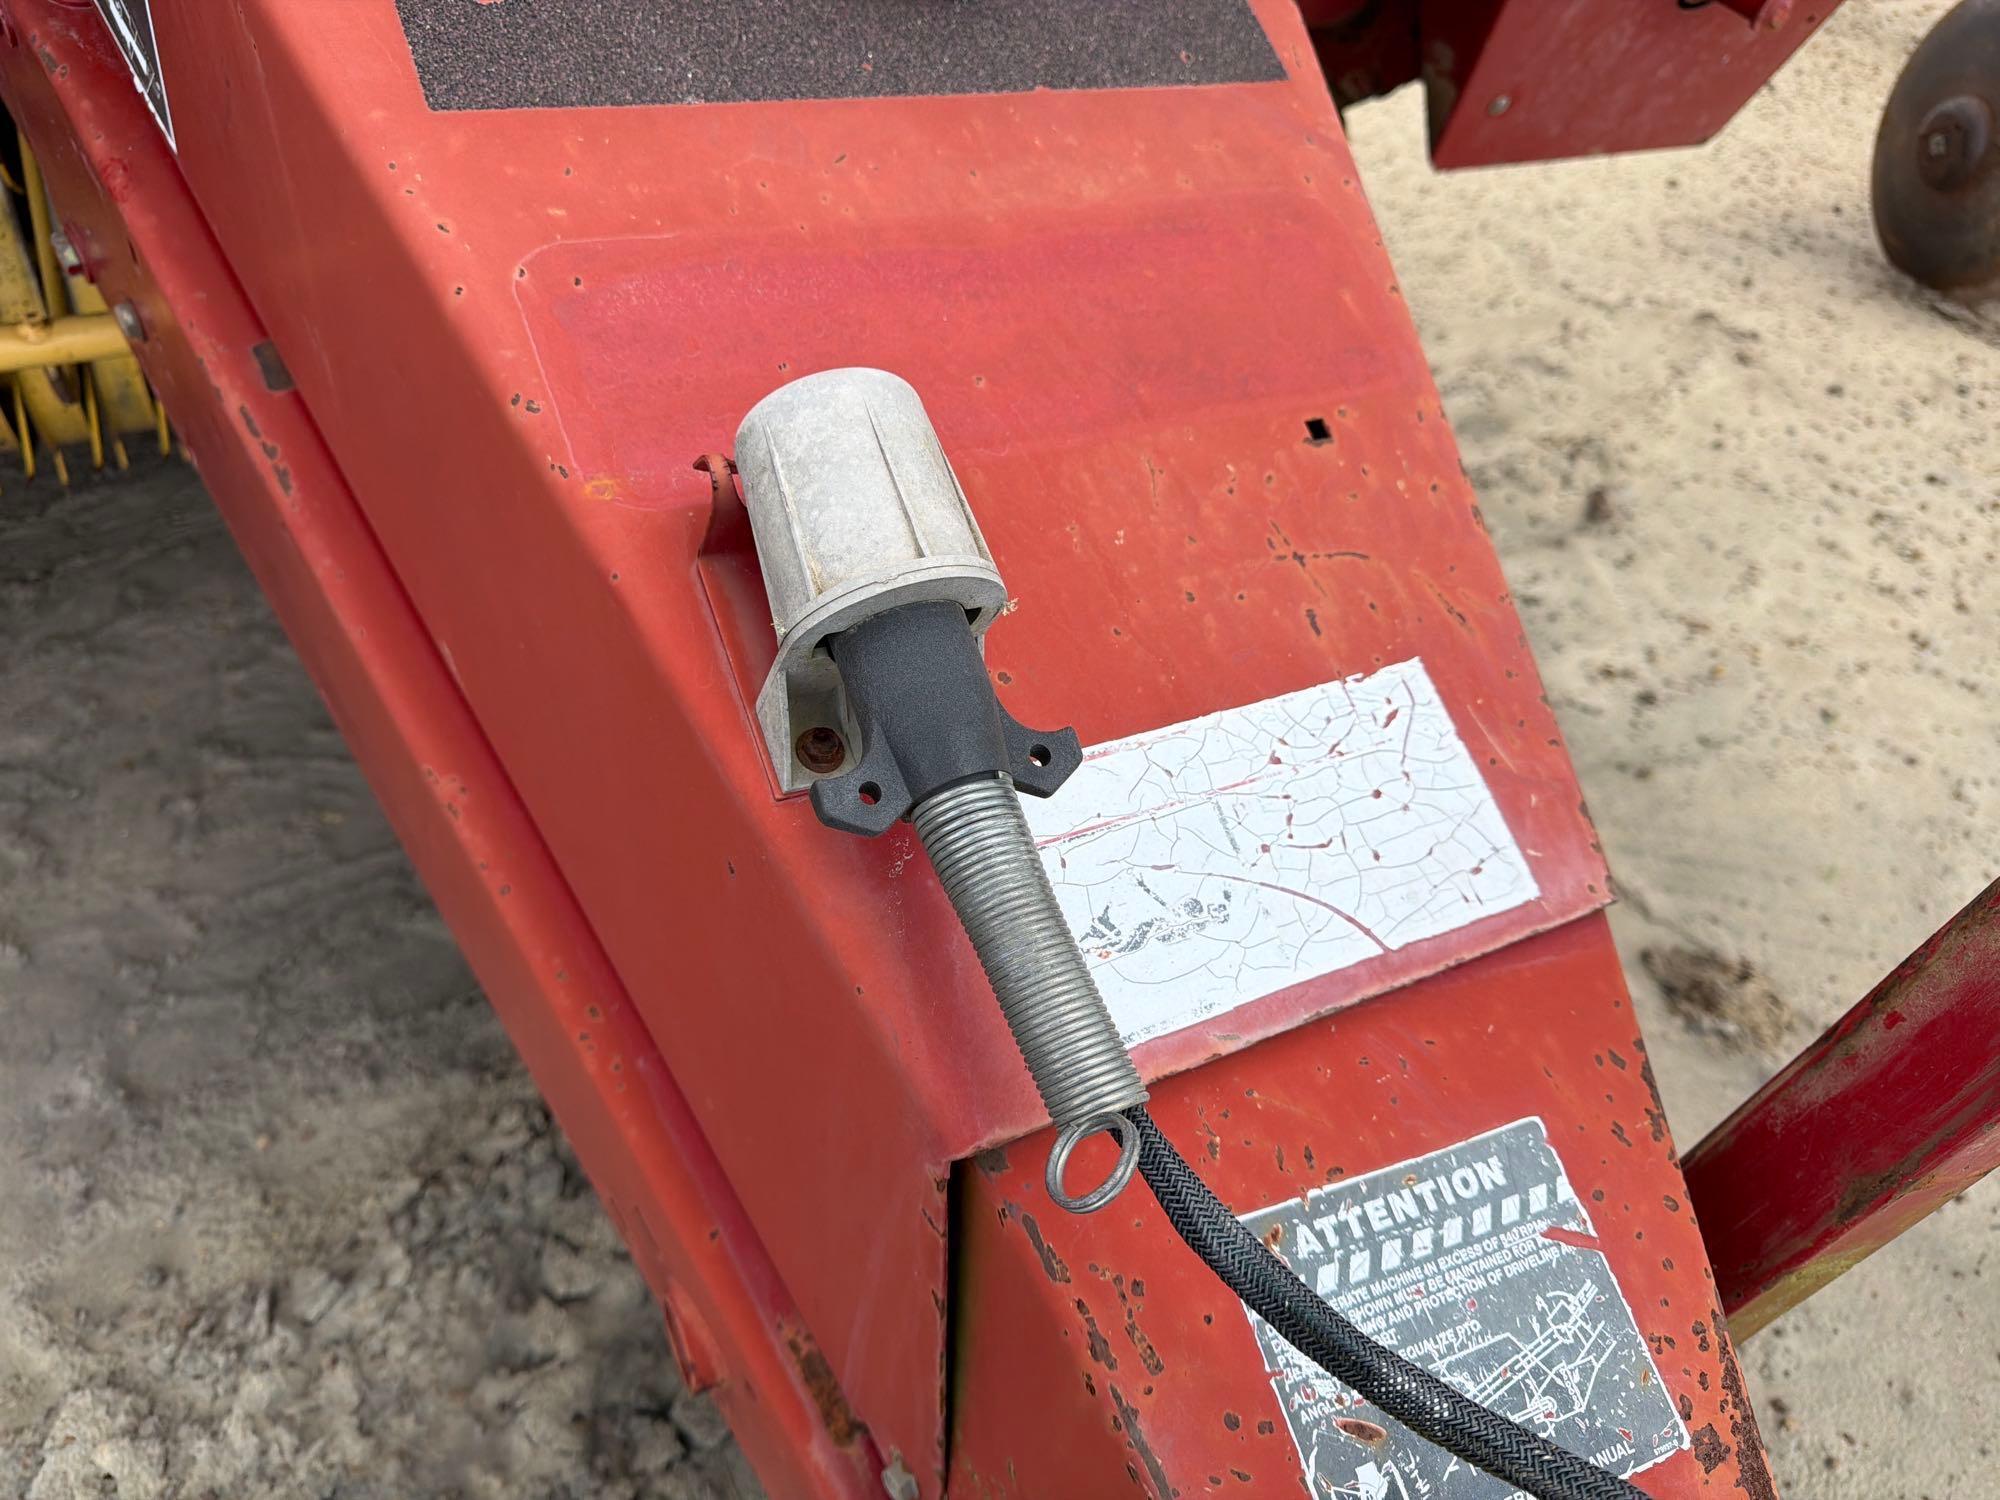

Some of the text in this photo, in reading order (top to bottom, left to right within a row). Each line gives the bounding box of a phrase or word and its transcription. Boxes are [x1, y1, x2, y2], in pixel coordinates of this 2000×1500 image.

[1296, 1155, 1507, 1259] ATTENTION
[1348, 1296, 1392, 1323] SHOWN
[1395, 1282, 1425, 1304] MUST
[1428, 1275, 1446, 1292] BE
[1445, 1250, 1512, 1284] MAINTAINED
[1512, 1240, 1537, 1259] FOR
[1371, 1268, 1424, 1297] MACHINE
[1423, 1261, 1438, 1277] IN
[1438, 1242, 1482, 1269] EXCESS
[1482, 1235, 1499, 1253] OF
[1389, 1304, 1414, 1321] AND
[1414, 1277, 1488, 1315] PROTECTION
[1487, 1269, 1503, 1286] OF
[1503, 1246, 1560, 1279] DRIVELINE
[1400, 1327, 1457, 1360] EQUALIZE
[1456, 1320, 1482, 1340] PTO
[1589, 1440, 1636, 1469] ANUAL
